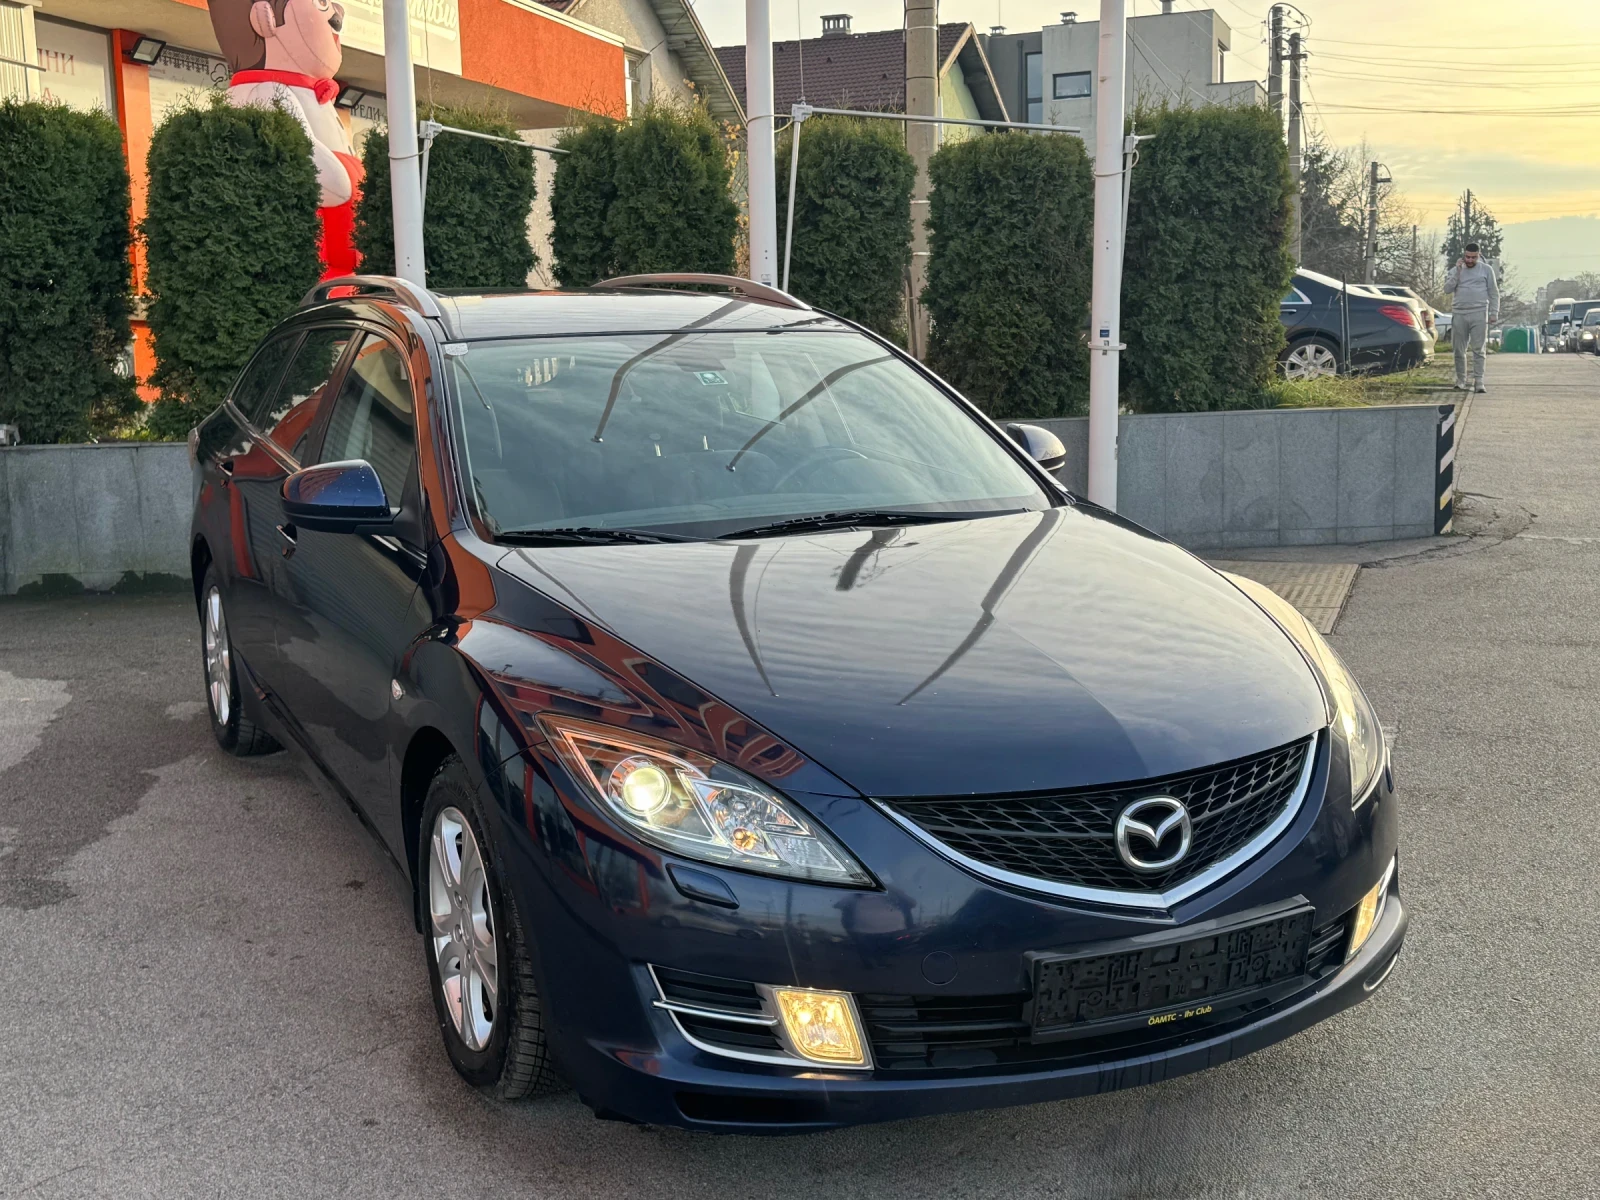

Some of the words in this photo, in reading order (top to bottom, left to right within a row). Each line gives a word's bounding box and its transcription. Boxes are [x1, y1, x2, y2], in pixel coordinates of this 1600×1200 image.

[1148, 1013, 1177, 1025] ÖAMTC
[1184, 1009, 1195, 1018] Ihr
[1195, 1005, 1212, 1015] Club
